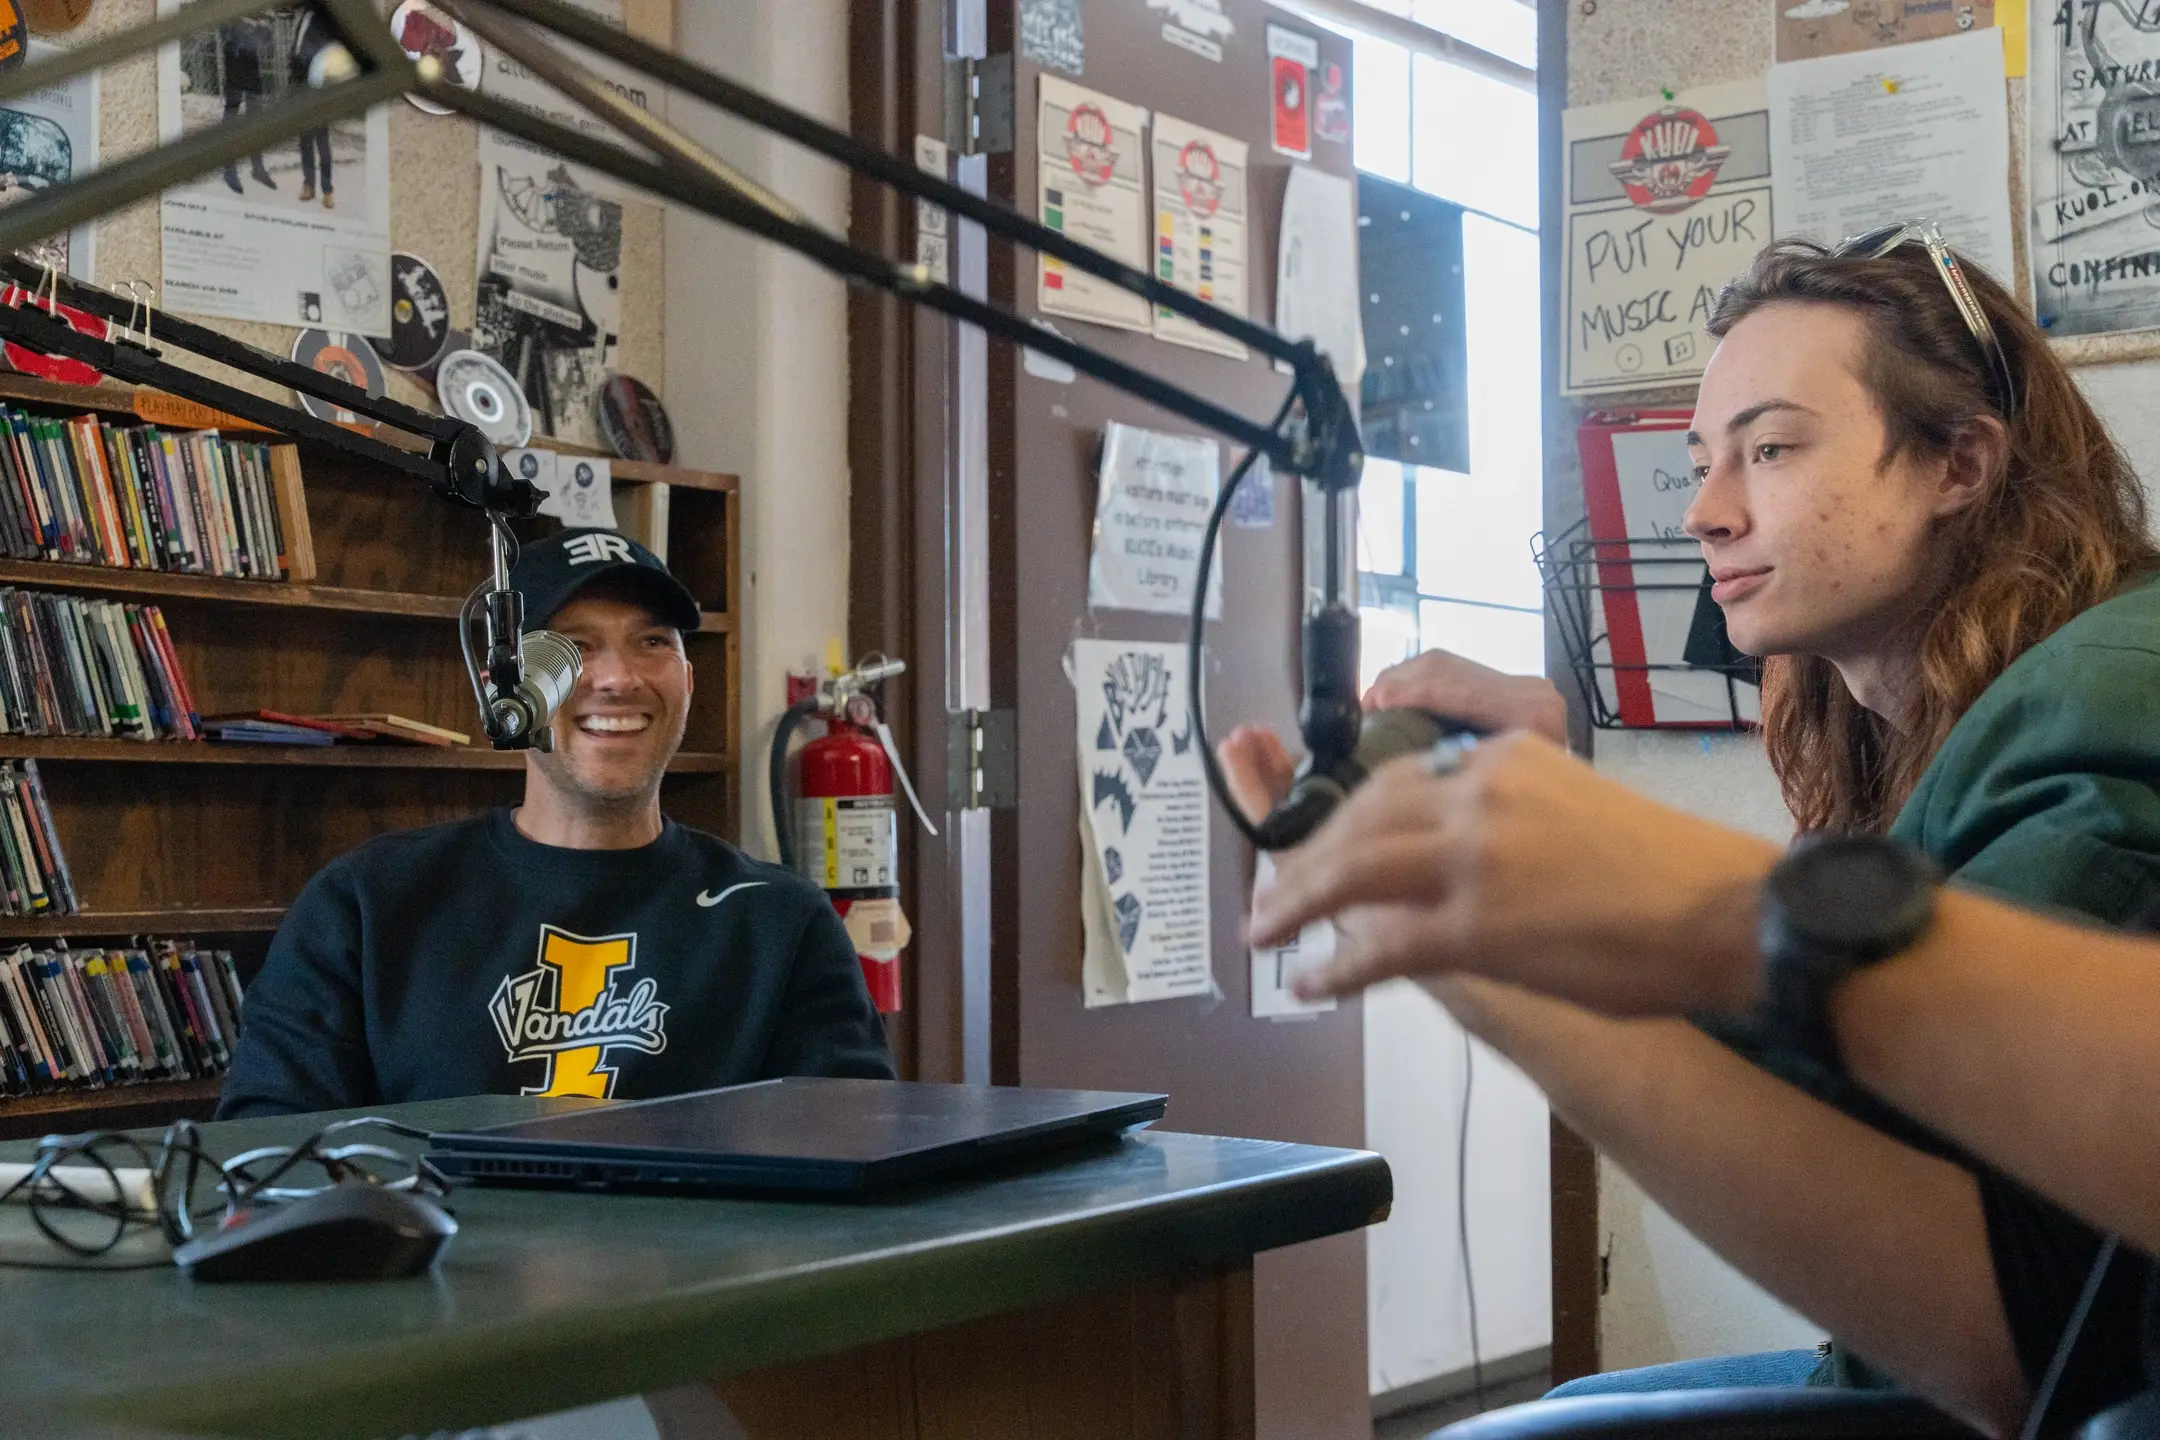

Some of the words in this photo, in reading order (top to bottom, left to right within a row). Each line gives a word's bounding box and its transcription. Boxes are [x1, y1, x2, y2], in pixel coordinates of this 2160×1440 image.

[1585, 218, 1654, 284] PUT
[1667, 199, 1757, 271] YOUR
[2049, 252, 2160, 287] CONFIN
[1581, 289, 1677, 351] MUSIC
[493, 976, 664, 1052] Vandals
